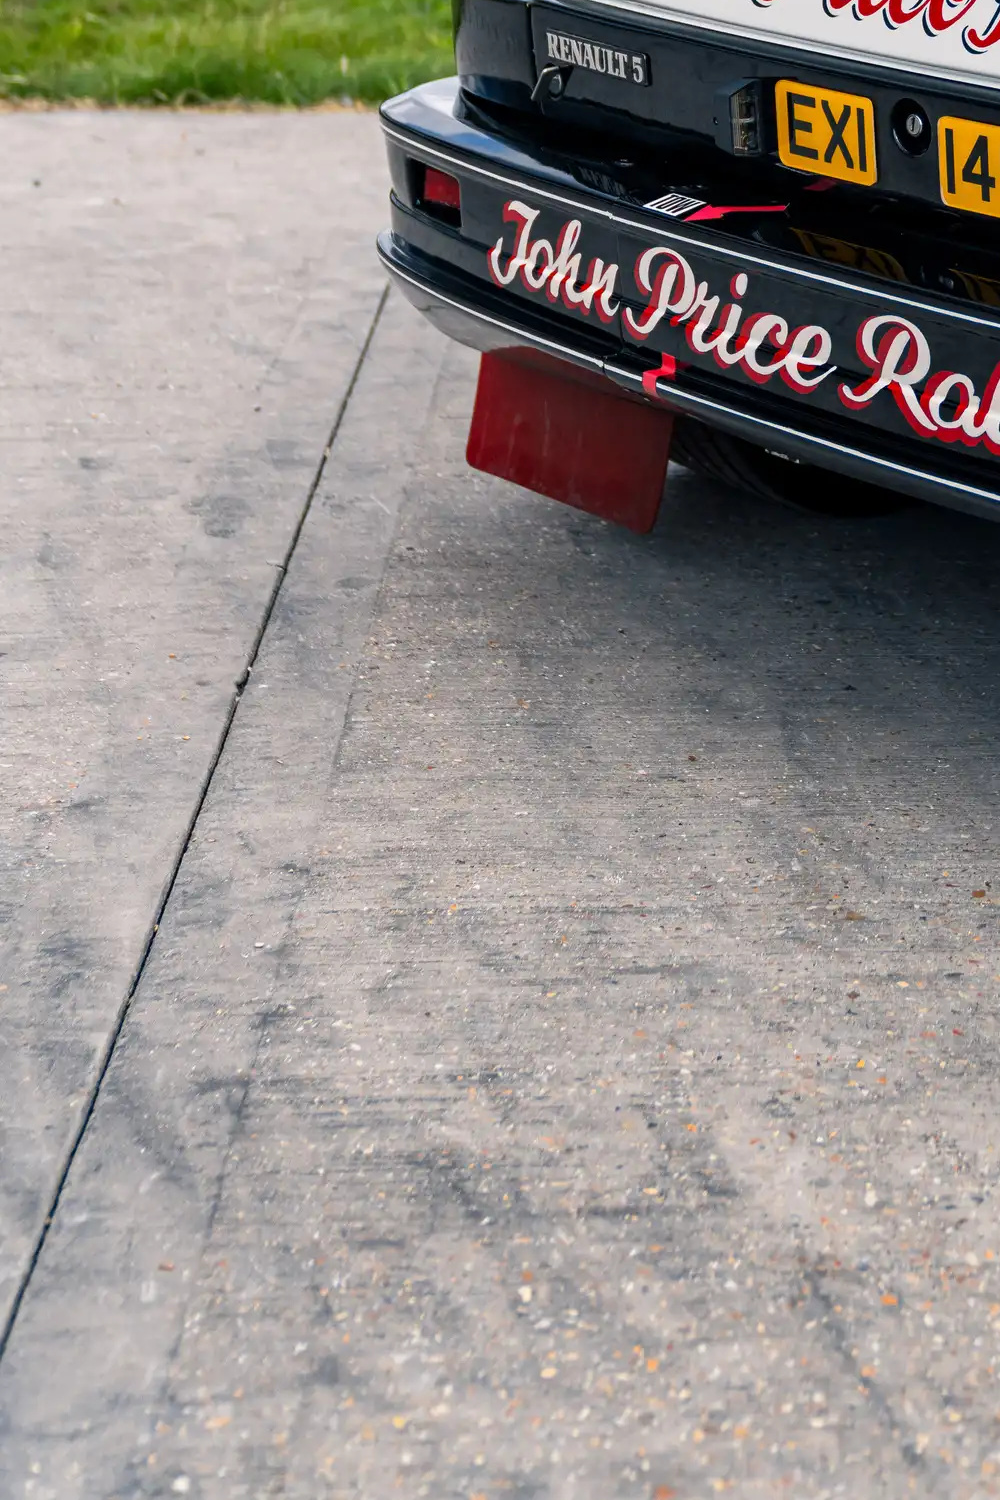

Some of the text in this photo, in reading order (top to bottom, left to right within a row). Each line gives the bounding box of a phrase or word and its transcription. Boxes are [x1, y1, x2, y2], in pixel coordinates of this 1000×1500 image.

[546, 32, 643, 83] RENAULT 5
[786, 91, 868, 173] EXI
[651, 193, 703, 215] TOW
[487, 199, 620, 324] John
[622, 245, 836, 393] Price
